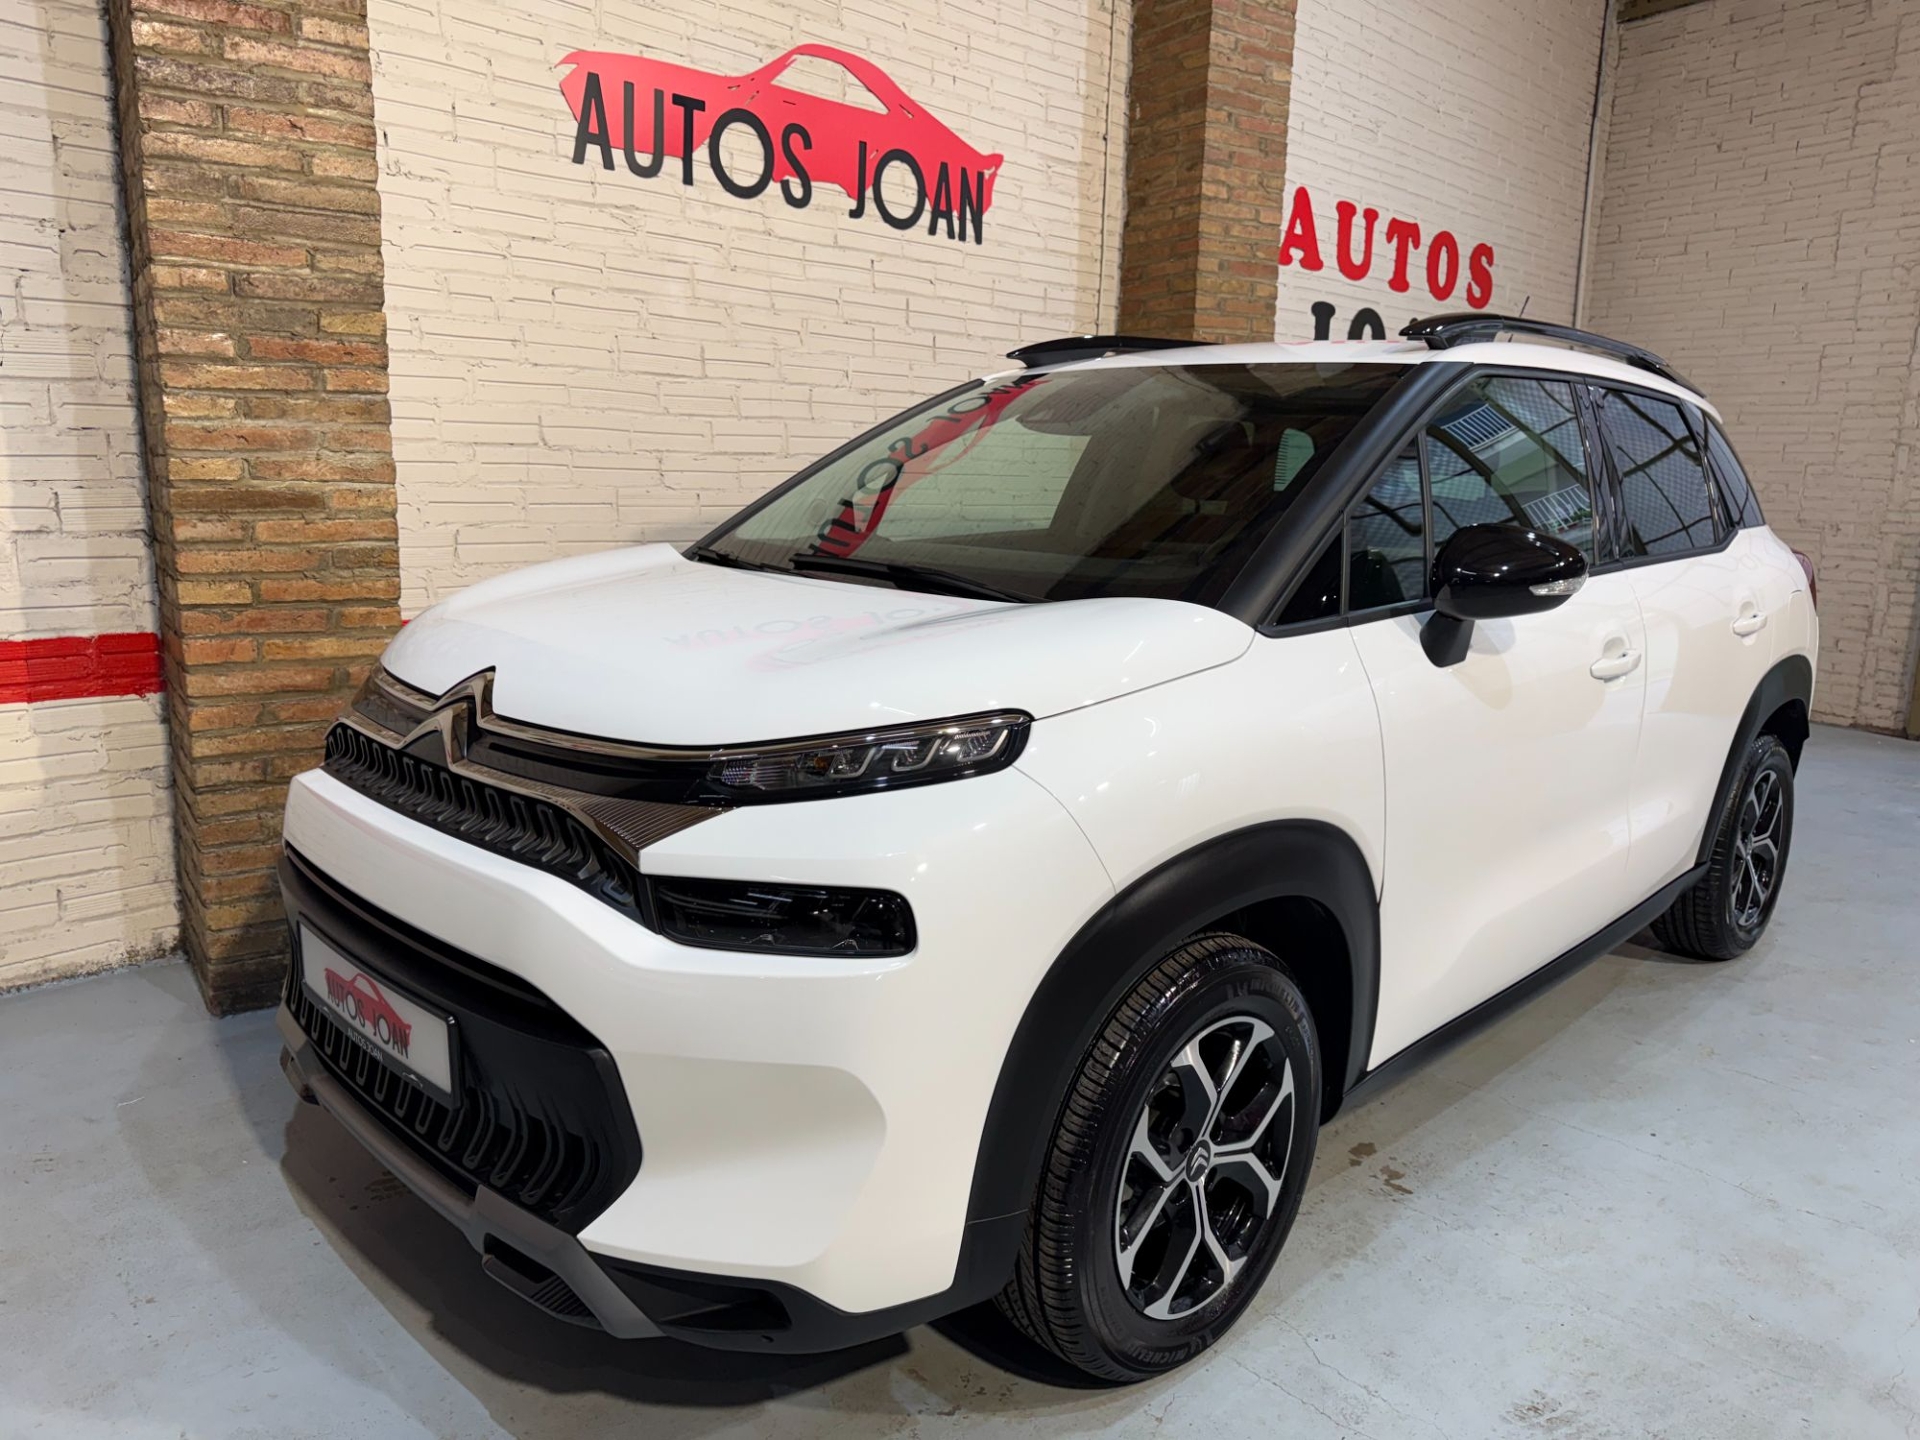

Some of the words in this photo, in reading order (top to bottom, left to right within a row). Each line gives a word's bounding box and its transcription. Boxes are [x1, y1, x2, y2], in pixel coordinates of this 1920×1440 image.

[571, 71, 813, 209] AUTOS
[848, 140, 985, 245] JOAN
[1277, 186, 1495, 310] AUTOS
[327, 974, 366, 1027] AUTOS
[372, 1008, 409, 1060] JOAN
